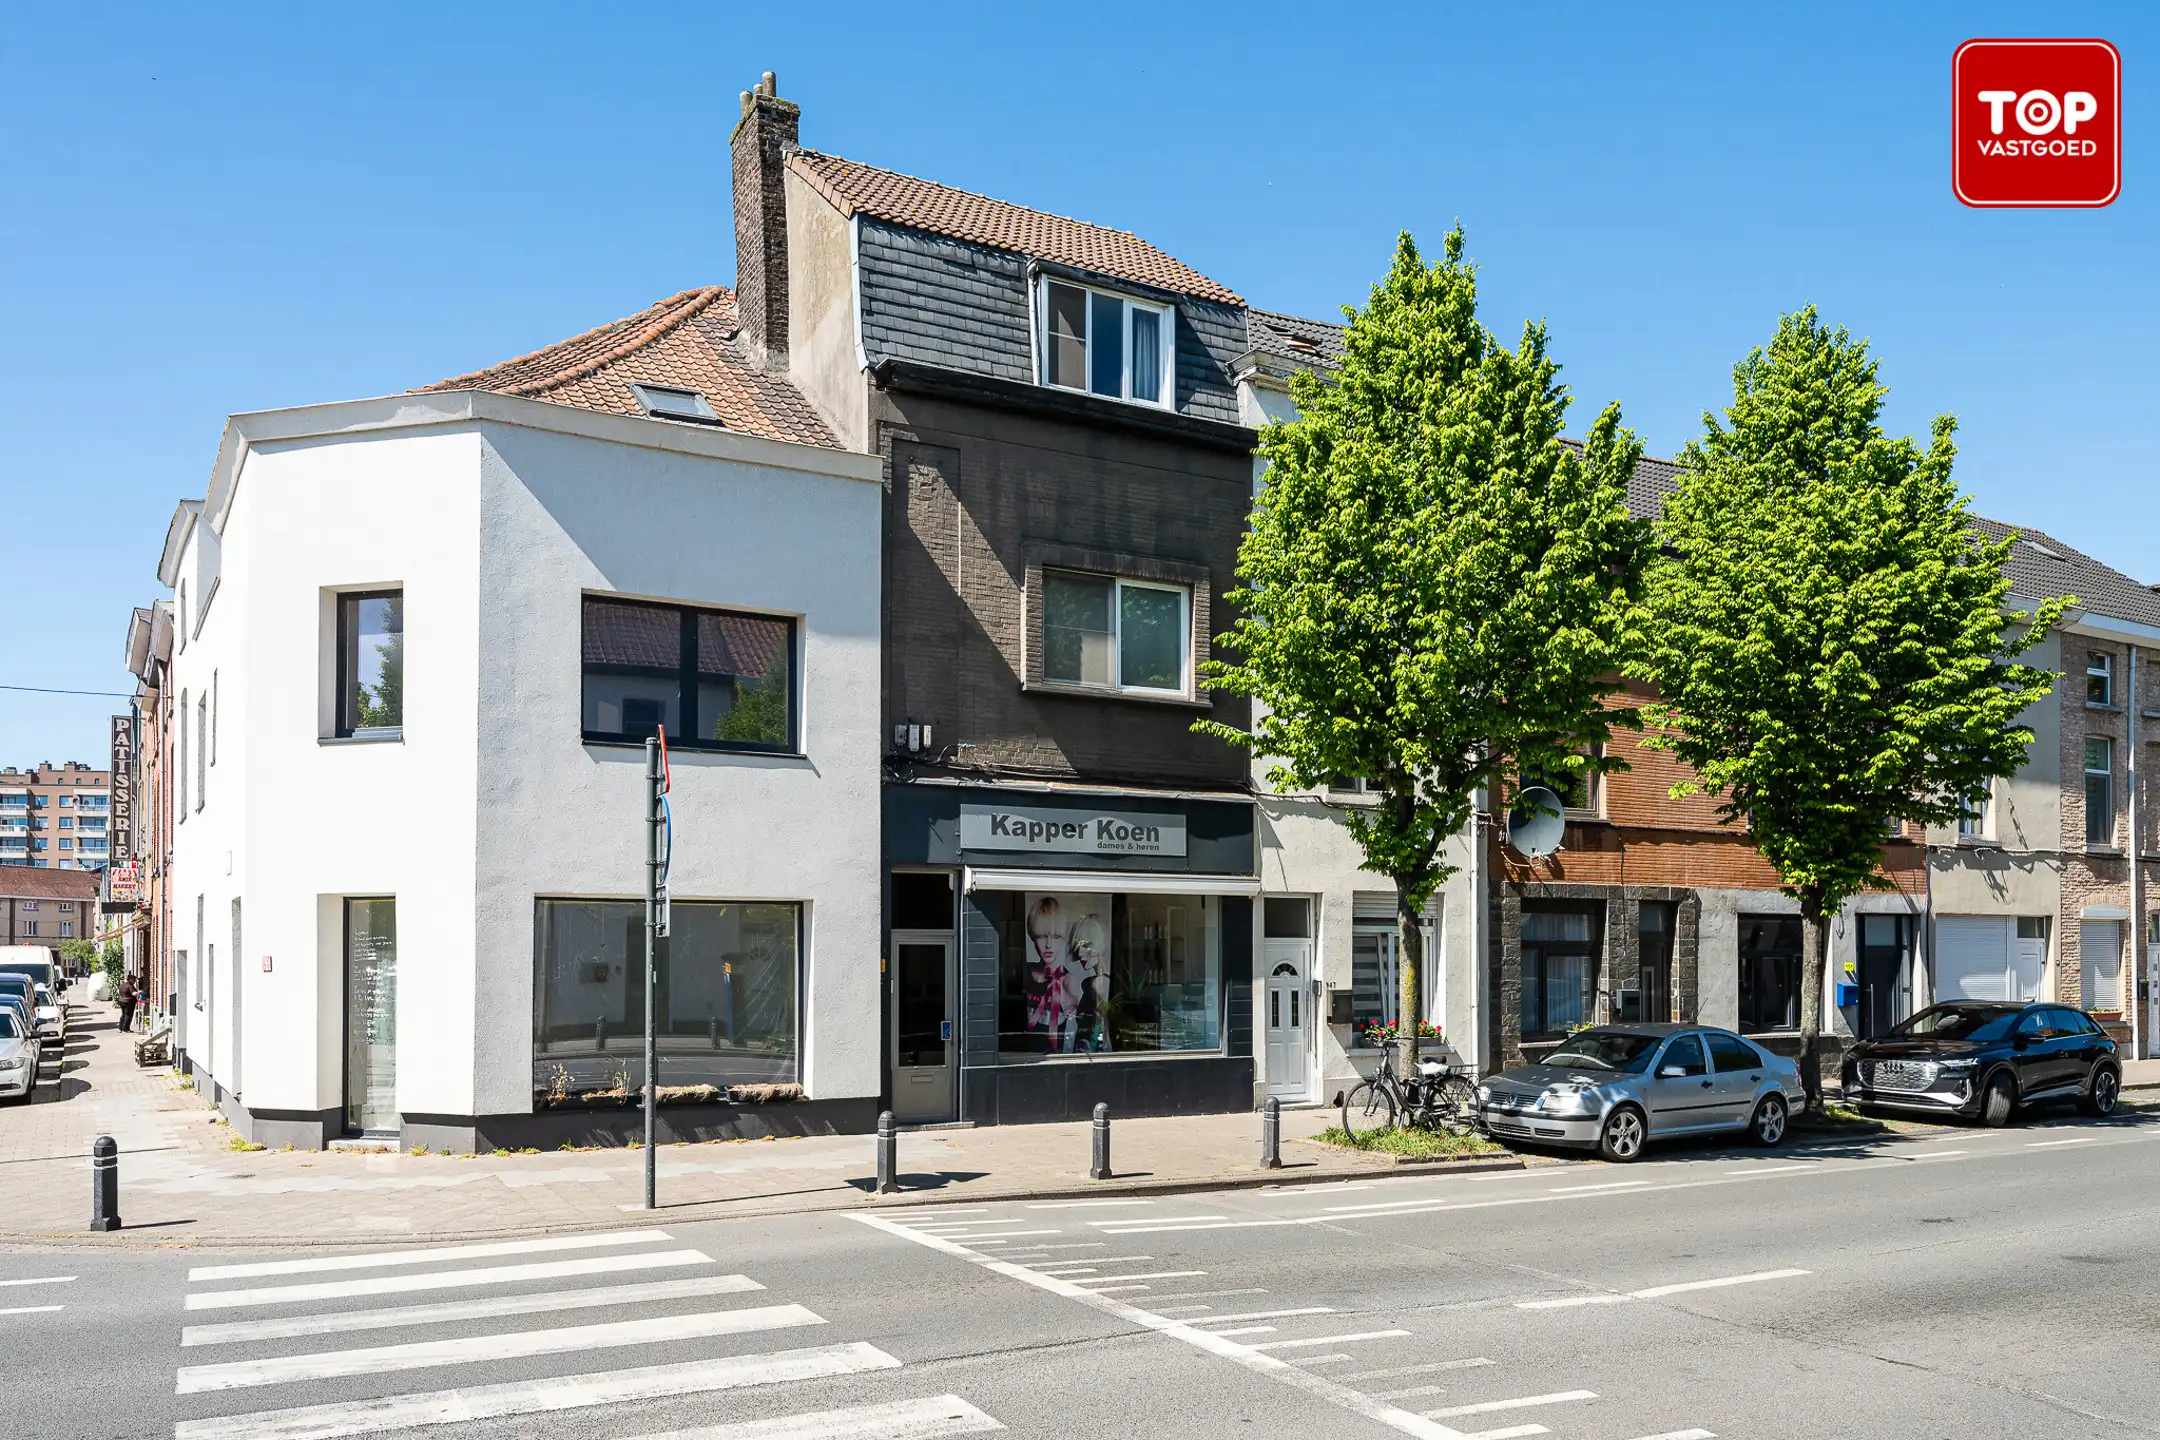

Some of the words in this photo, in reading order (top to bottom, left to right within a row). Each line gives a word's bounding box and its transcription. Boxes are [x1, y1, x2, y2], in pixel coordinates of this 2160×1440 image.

[114, 718, 130, 859] PATISSERIE
[991, 813, 1088, 843] Kapper
[1097, 819, 1159, 842] Koen
[1097, 842, 1125, 850] dames
[1136, 843, 1159, 851] heren
